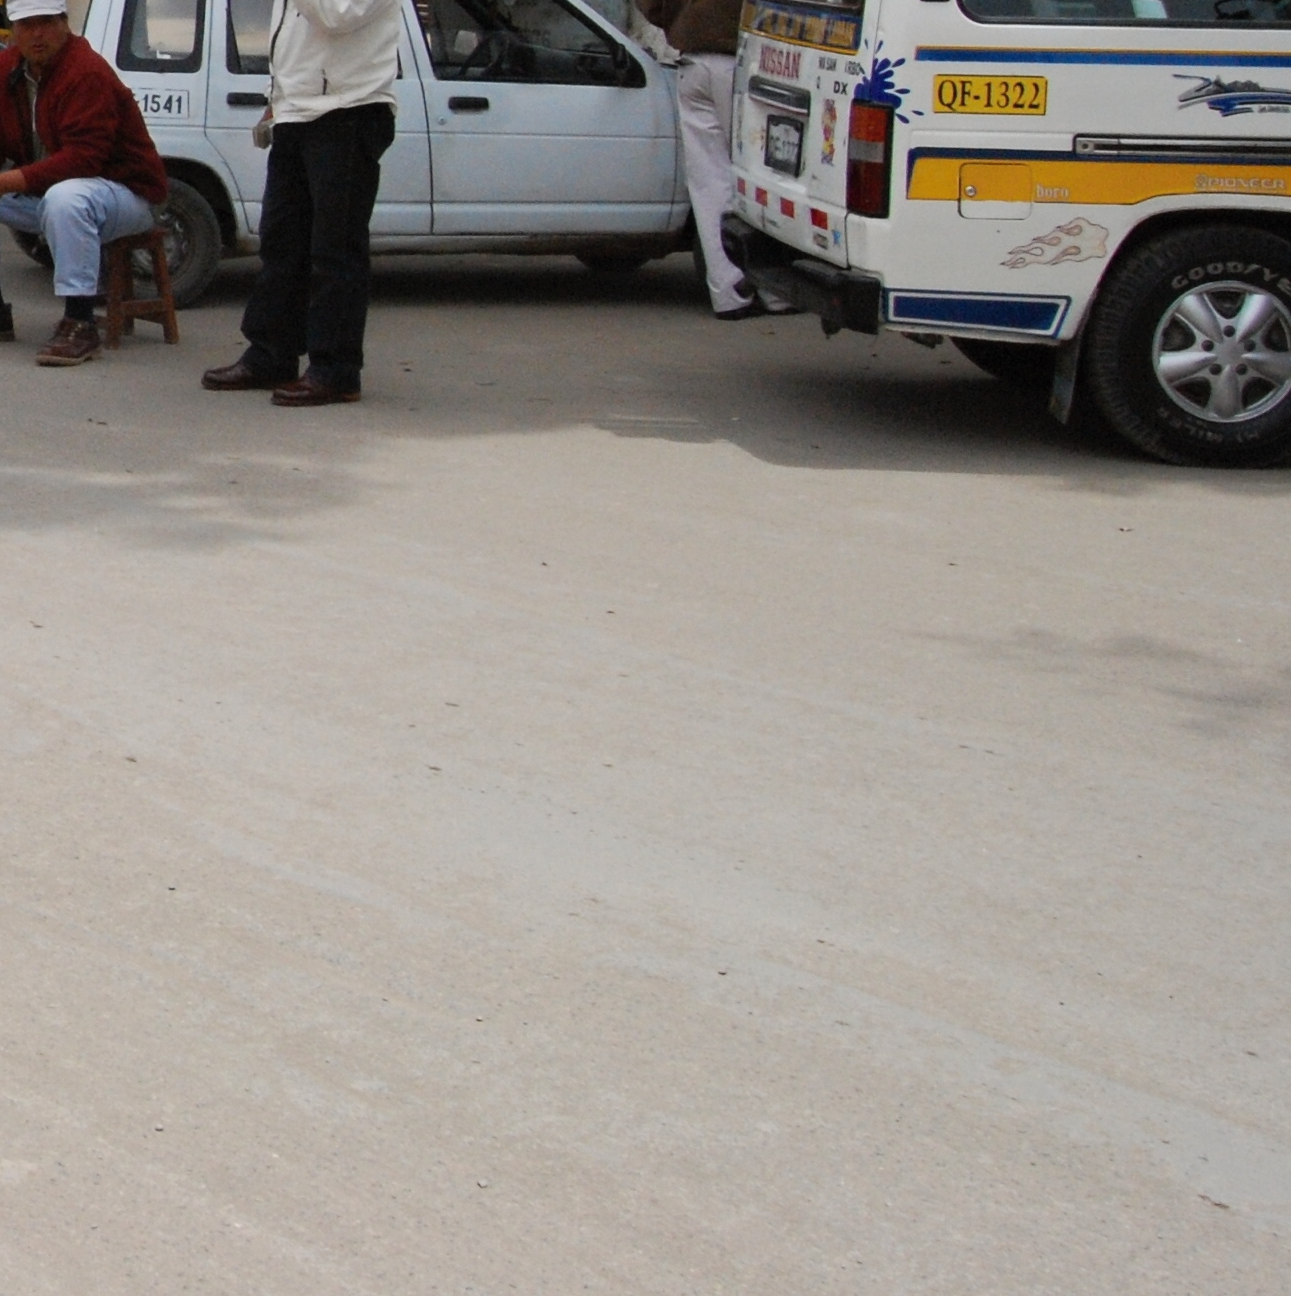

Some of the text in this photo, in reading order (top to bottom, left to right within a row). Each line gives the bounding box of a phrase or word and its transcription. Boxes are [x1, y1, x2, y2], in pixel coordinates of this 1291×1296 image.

[759, 44, 802, 79] NISSAN
[834, 80, 849, 96] DX
[937, 79, 1041, 112] QF-1322
[132, 93, 182, 114] -1541
